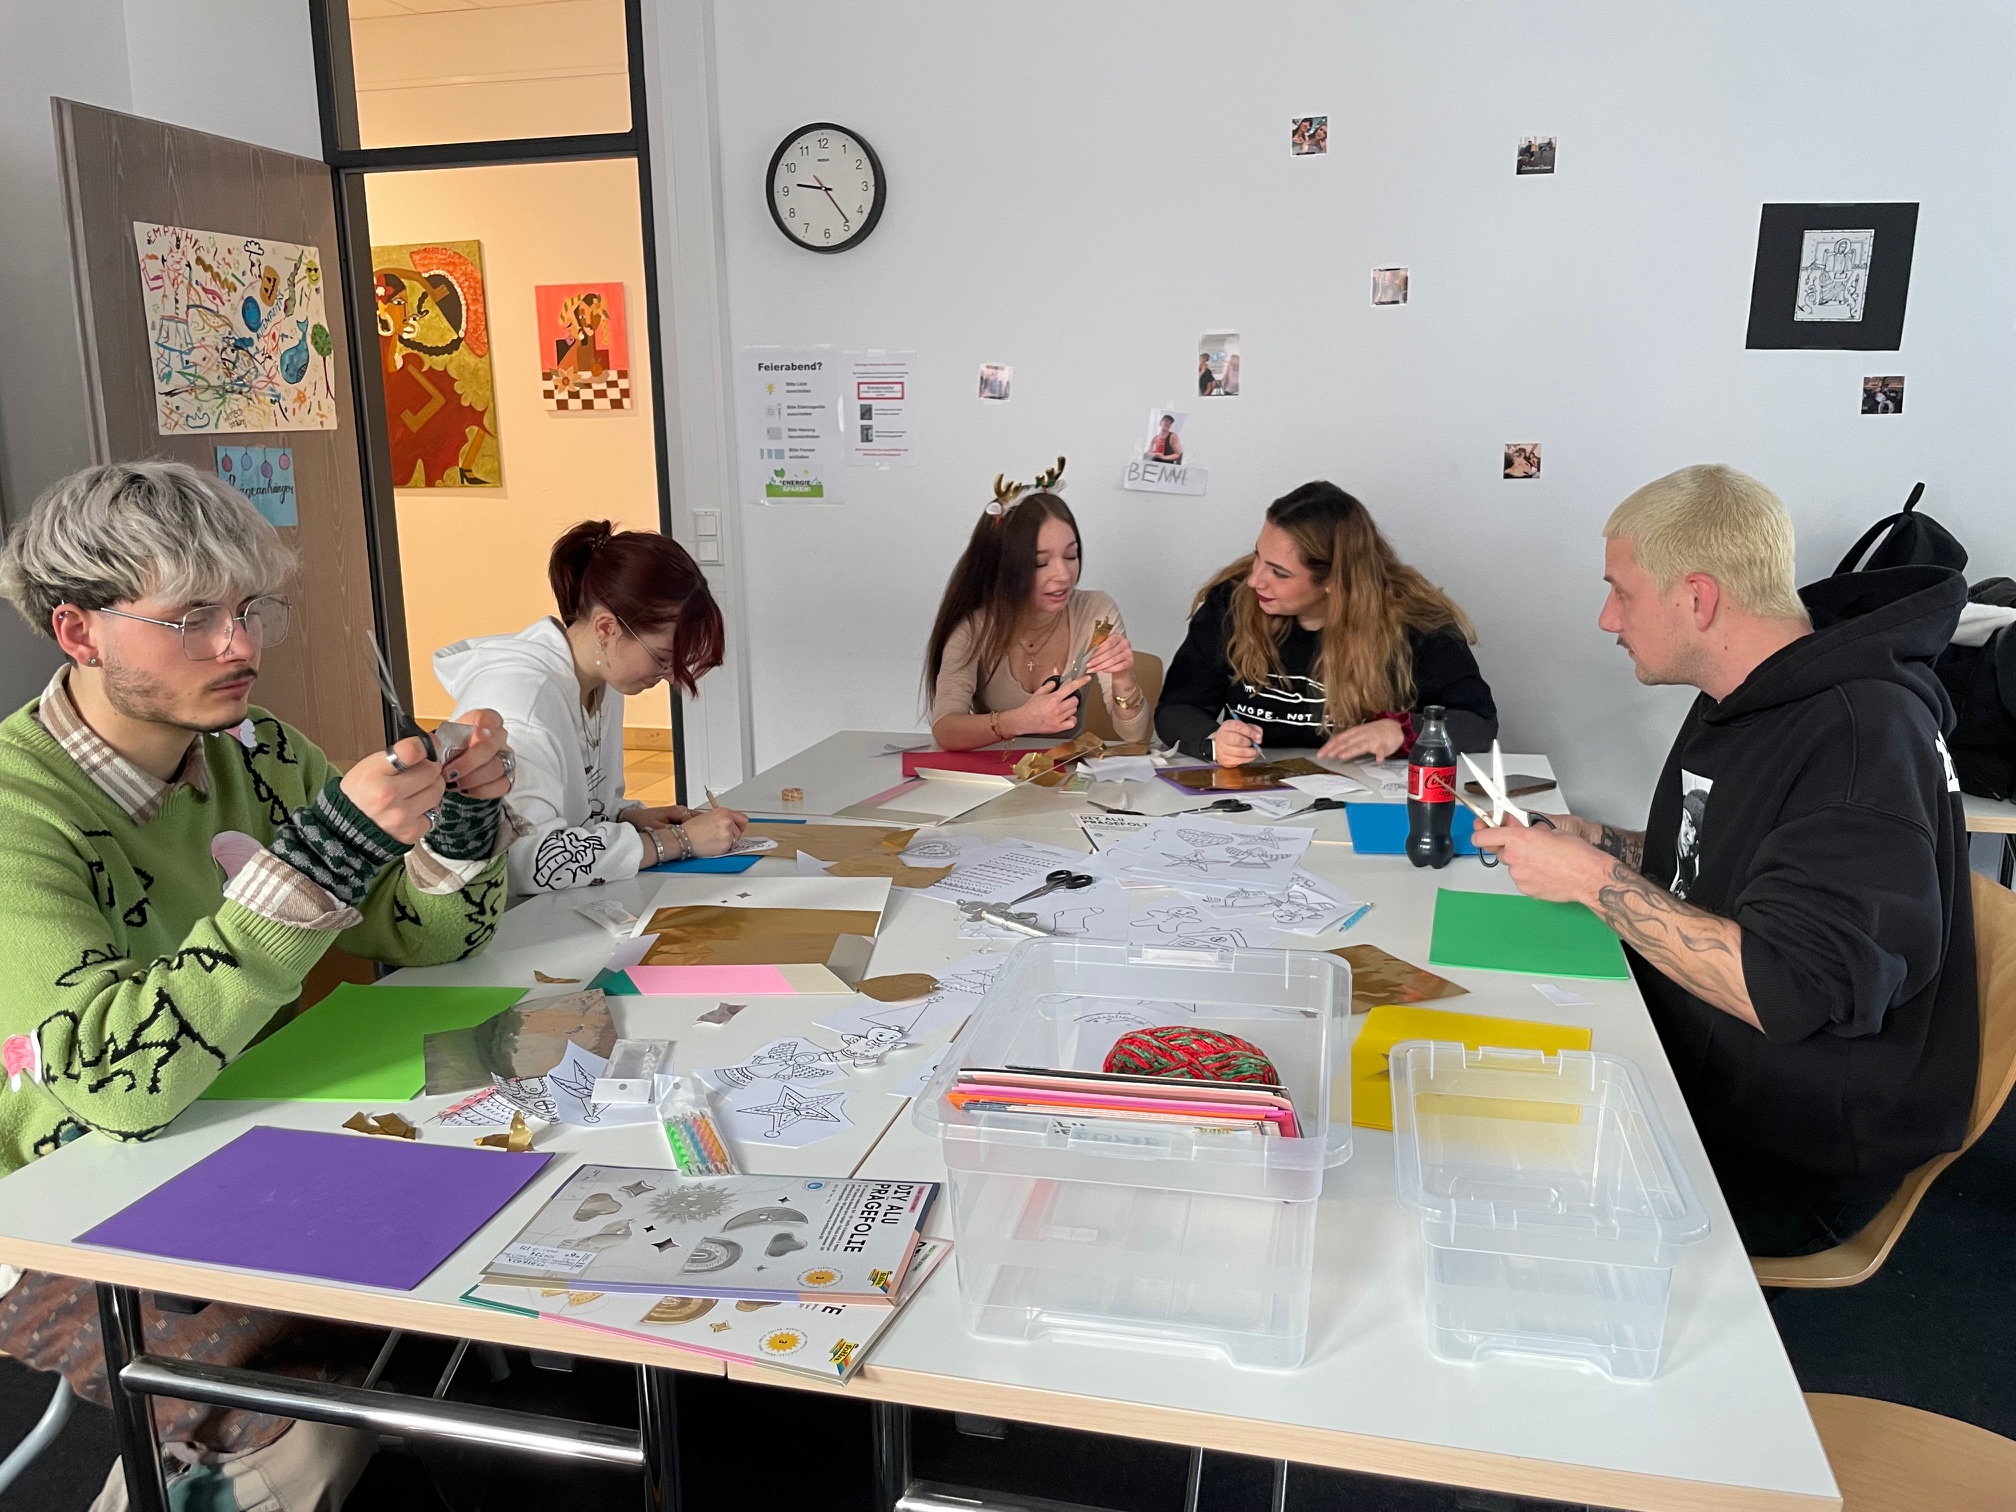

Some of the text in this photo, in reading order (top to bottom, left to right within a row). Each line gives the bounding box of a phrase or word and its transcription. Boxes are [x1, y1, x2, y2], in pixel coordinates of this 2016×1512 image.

[817, 137, 829, 149] 12
[842, 143, 847, 154] 1
[799, 145, 809, 156] 11
[785, 162, 796, 173] 10
[855, 158, 863, 170] 2
[782, 185, 790, 197] 9
[861, 180, 869, 192] 3
[788, 207, 796, 219] 8
[856, 204, 864, 216] 4
[803, 222, 810, 234] 7
[843, 221, 850, 232] 5
[824, 228, 831, 239] 6
[758, 362, 823, 372] Feierabend?
[227, 474, 294, 505] Pägeanhänger
[1287, 713, 1313, 721] NOT
[881, 1184, 914, 1225] DIY ALU
[843, 1183, 892, 1252] PRÄGEFOLIE
